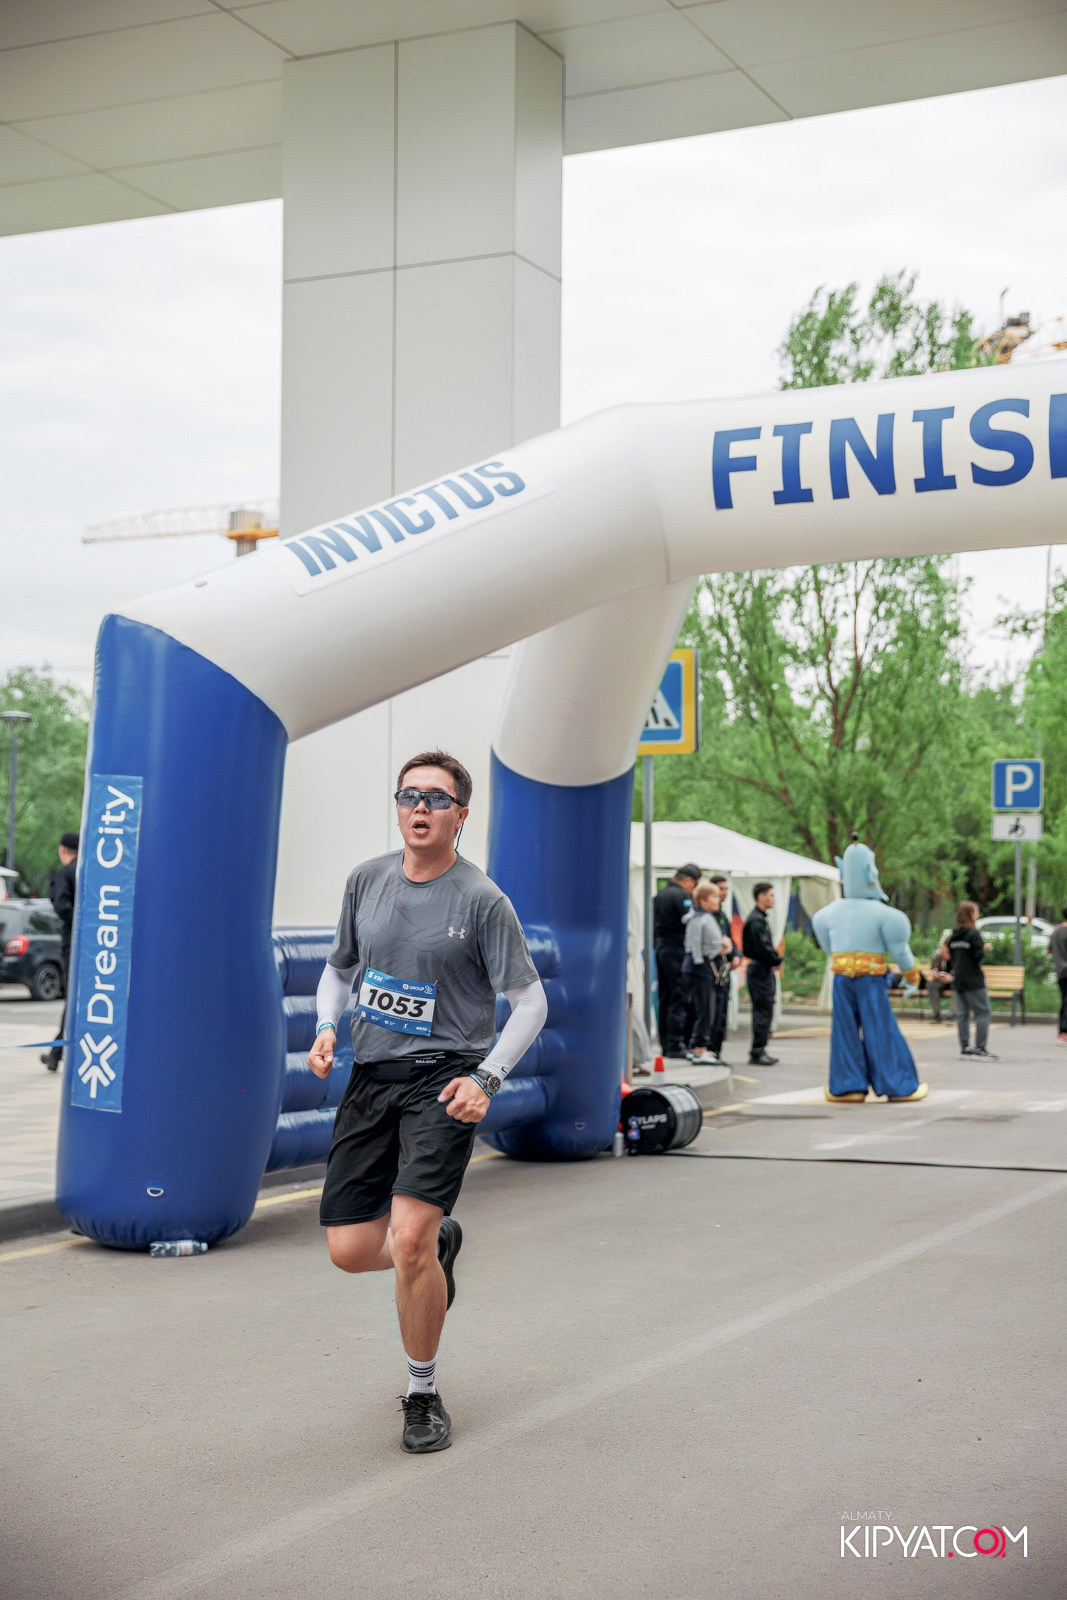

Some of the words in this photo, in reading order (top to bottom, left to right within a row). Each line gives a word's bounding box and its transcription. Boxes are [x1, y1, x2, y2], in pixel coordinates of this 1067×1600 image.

[712, 392, 1067, 510] FINIS
[284, 461, 526, 577] INVICTUS
[96, 785, 135, 869] City
[1005, 763, 1035, 807] P
[86, 884, 121, 1025] Dream
[367, 989, 428, 1018] 1053
